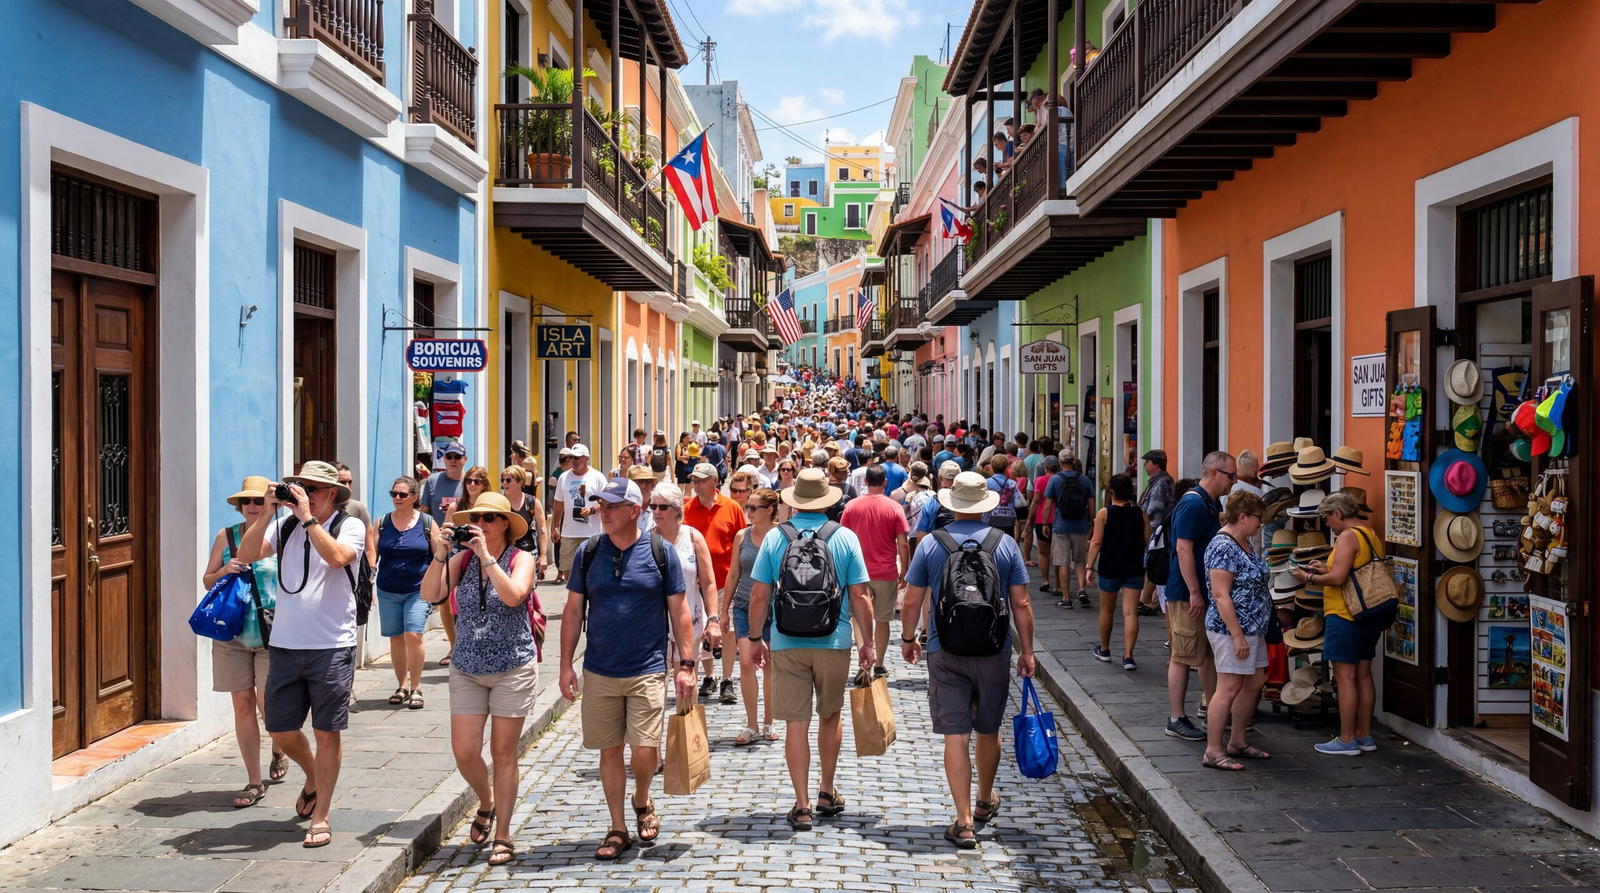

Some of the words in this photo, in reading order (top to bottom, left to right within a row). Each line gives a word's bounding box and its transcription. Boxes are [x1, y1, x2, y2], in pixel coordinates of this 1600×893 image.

[543, 327, 586, 342] ISLA
[414, 342, 481, 356] BORICUA
[545, 342, 585, 356] ART
[412, 356, 482, 368] SOUVENIRS
[1024, 354, 1042, 363] SAN
[1043, 354, 1066, 363] JUAN
[1033, 363, 1057, 371] GIFTS
[1353, 364, 1369, 385] SAN
[1370, 362, 1386, 383] JUA
[1361, 387, 1384, 407] GIFTS
